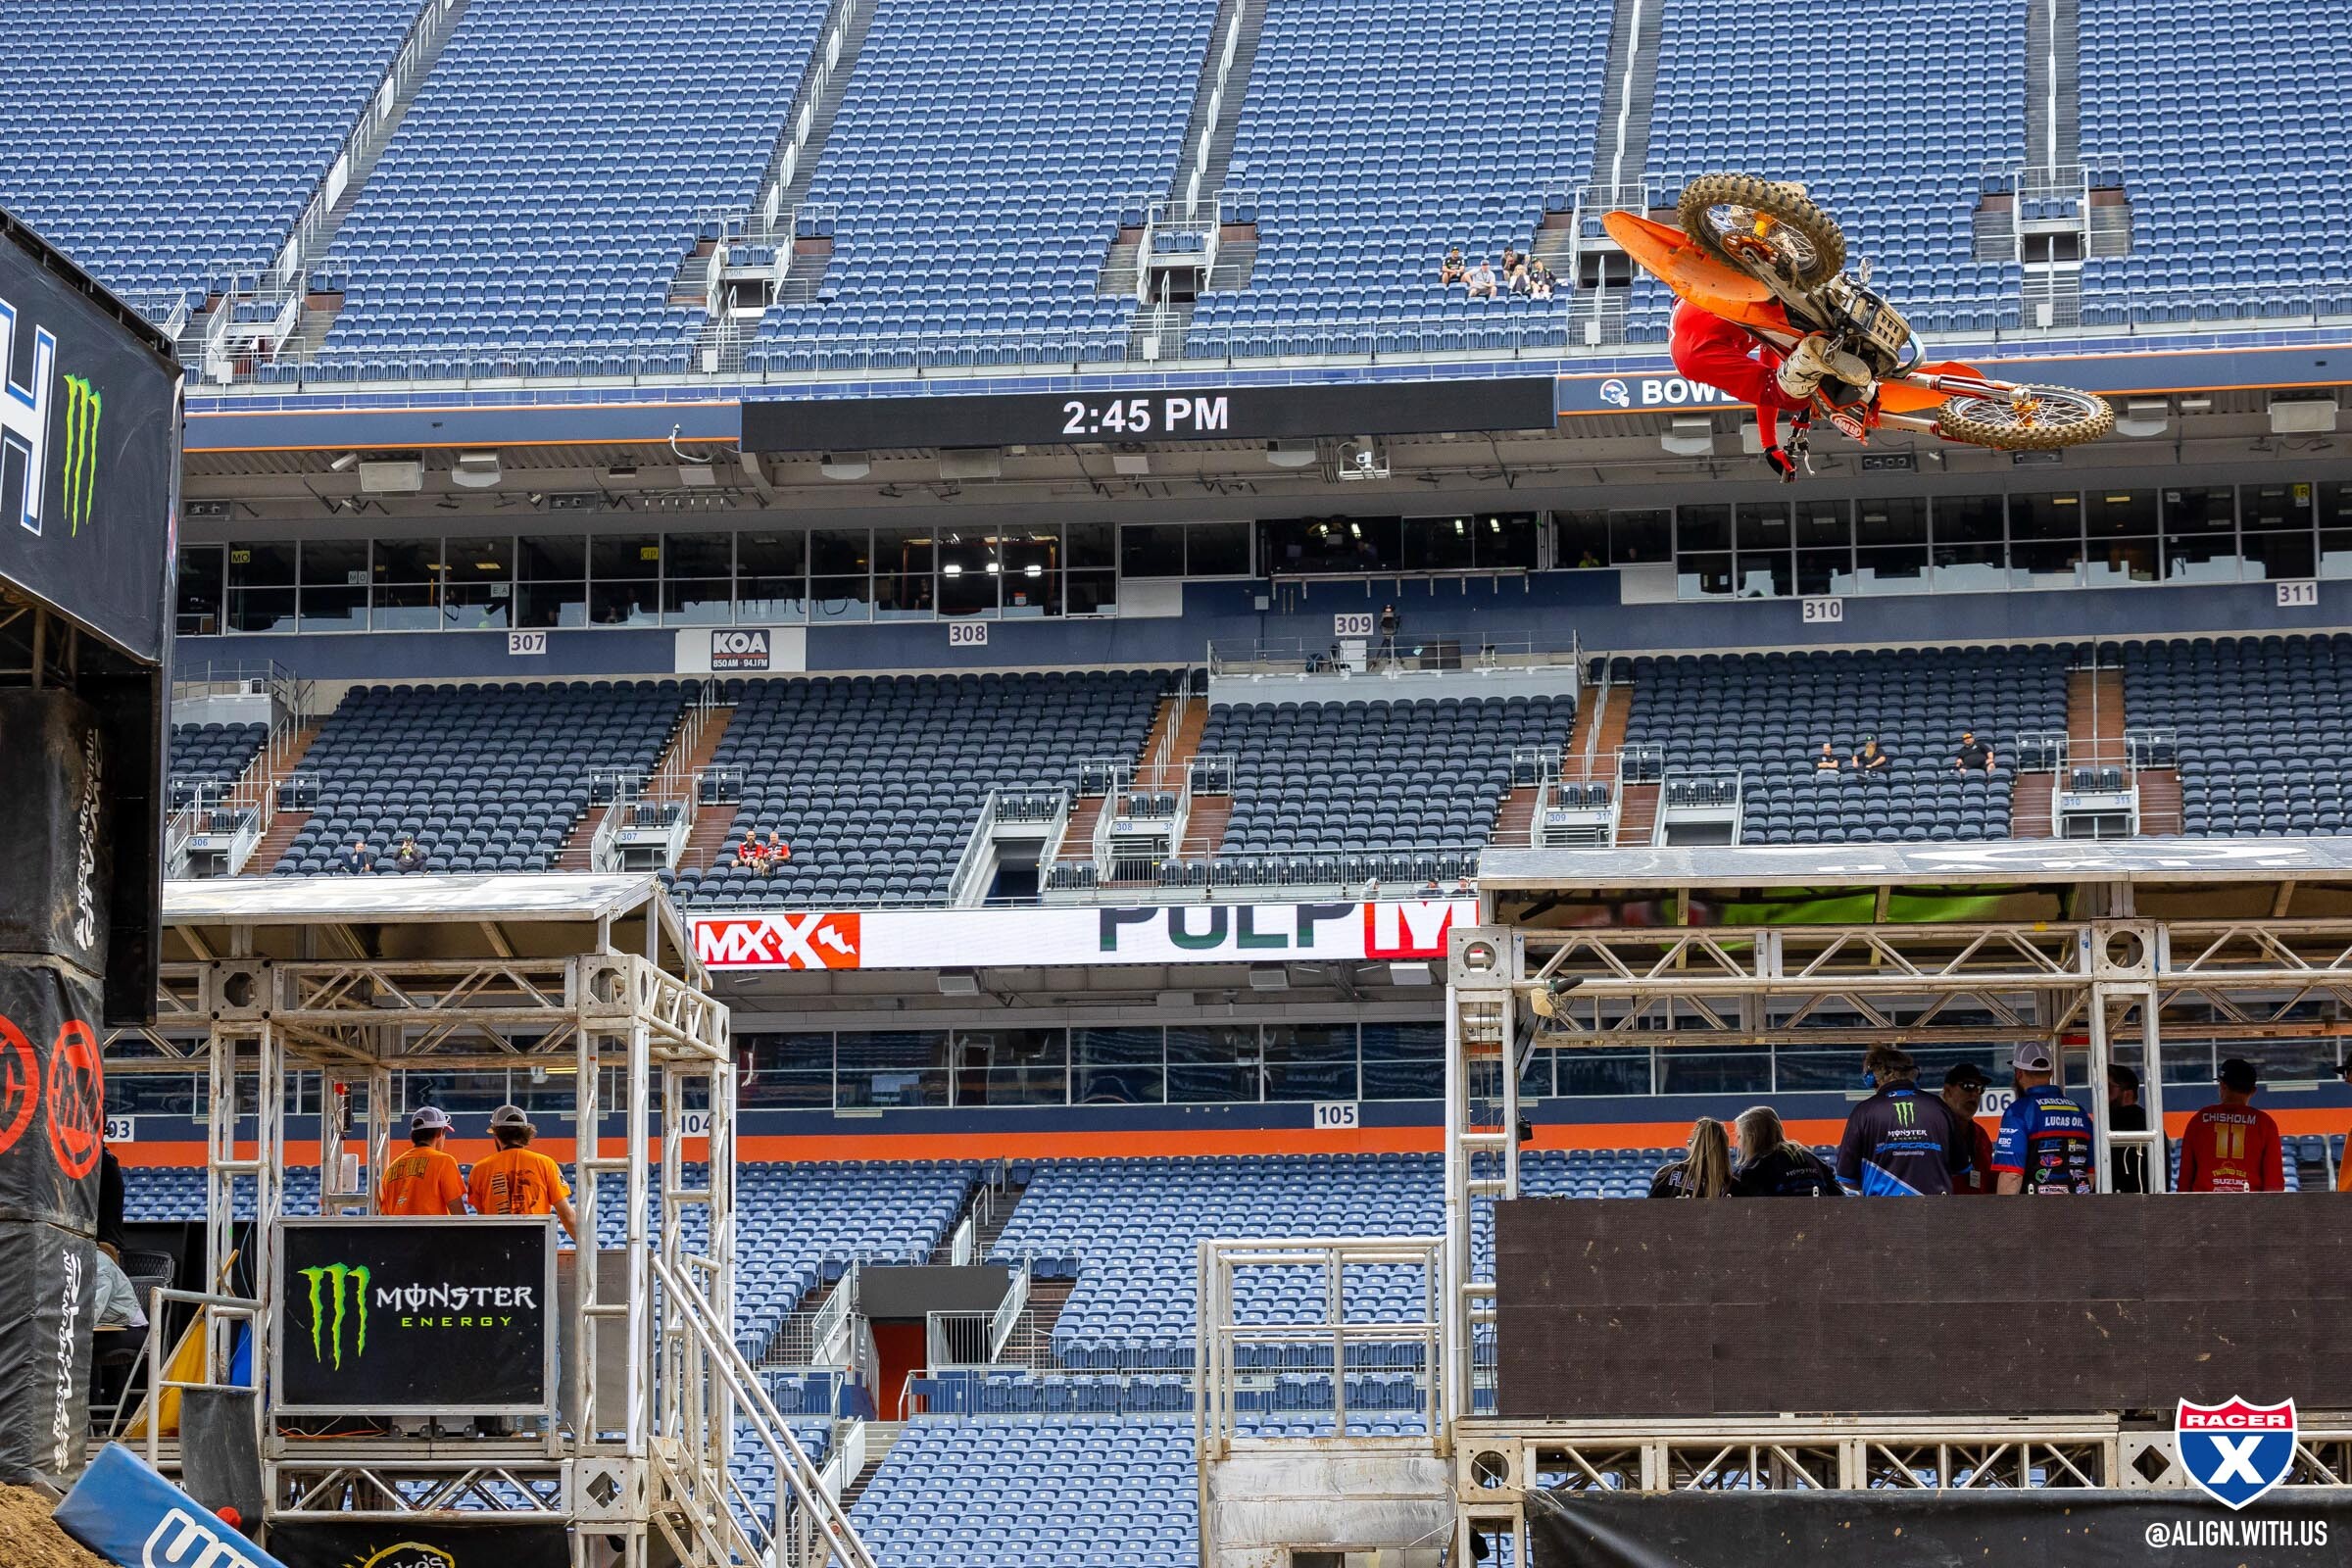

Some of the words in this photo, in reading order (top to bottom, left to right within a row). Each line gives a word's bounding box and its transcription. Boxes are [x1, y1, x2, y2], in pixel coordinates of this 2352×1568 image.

[1062, 400, 1151, 434] 2:45
[1165, 397, 1228, 431] PM
[2279, 585, 2314, 602] 311
[1805, 601, 1840, 620] 310
[952, 624, 986, 643] 308
[1337, 615, 1371, 634] 309
[511, 634, 545, 652] 307
[713, 633, 767, 653] KOA
[713, 659, 727, 667] 850
[2063, 797, 2082, 807] 310
[2114, 795, 2132, 806] 311
[1116, 822, 1133, 831] 308
[1549, 813, 1566, 822] 309
[191, 837, 209, 847] 306
[621, 832, 637, 841] 307
[77, 841, 87, 913] ROCKY
[1318, 1106, 1354, 1125] 105
[2044, 1116, 2070, 1127] LUCAS
[2071, 1117, 2084, 1127] OIL
[2202, 1112, 2256, 1126] CHISHOLM
[107, 1119, 130, 1139] 03
[1887, 1129, 1928, 1138] MONSTER
[2215, 1122, 2246, 1159] 11
[375, 1281, 537, 1312] MONSTER
[57, 1249, 74, 1368] MOUNTAIN
[402, 1317, 513, 1328] ENERGY
[53, 1369, 65, 1441] ROCKY
